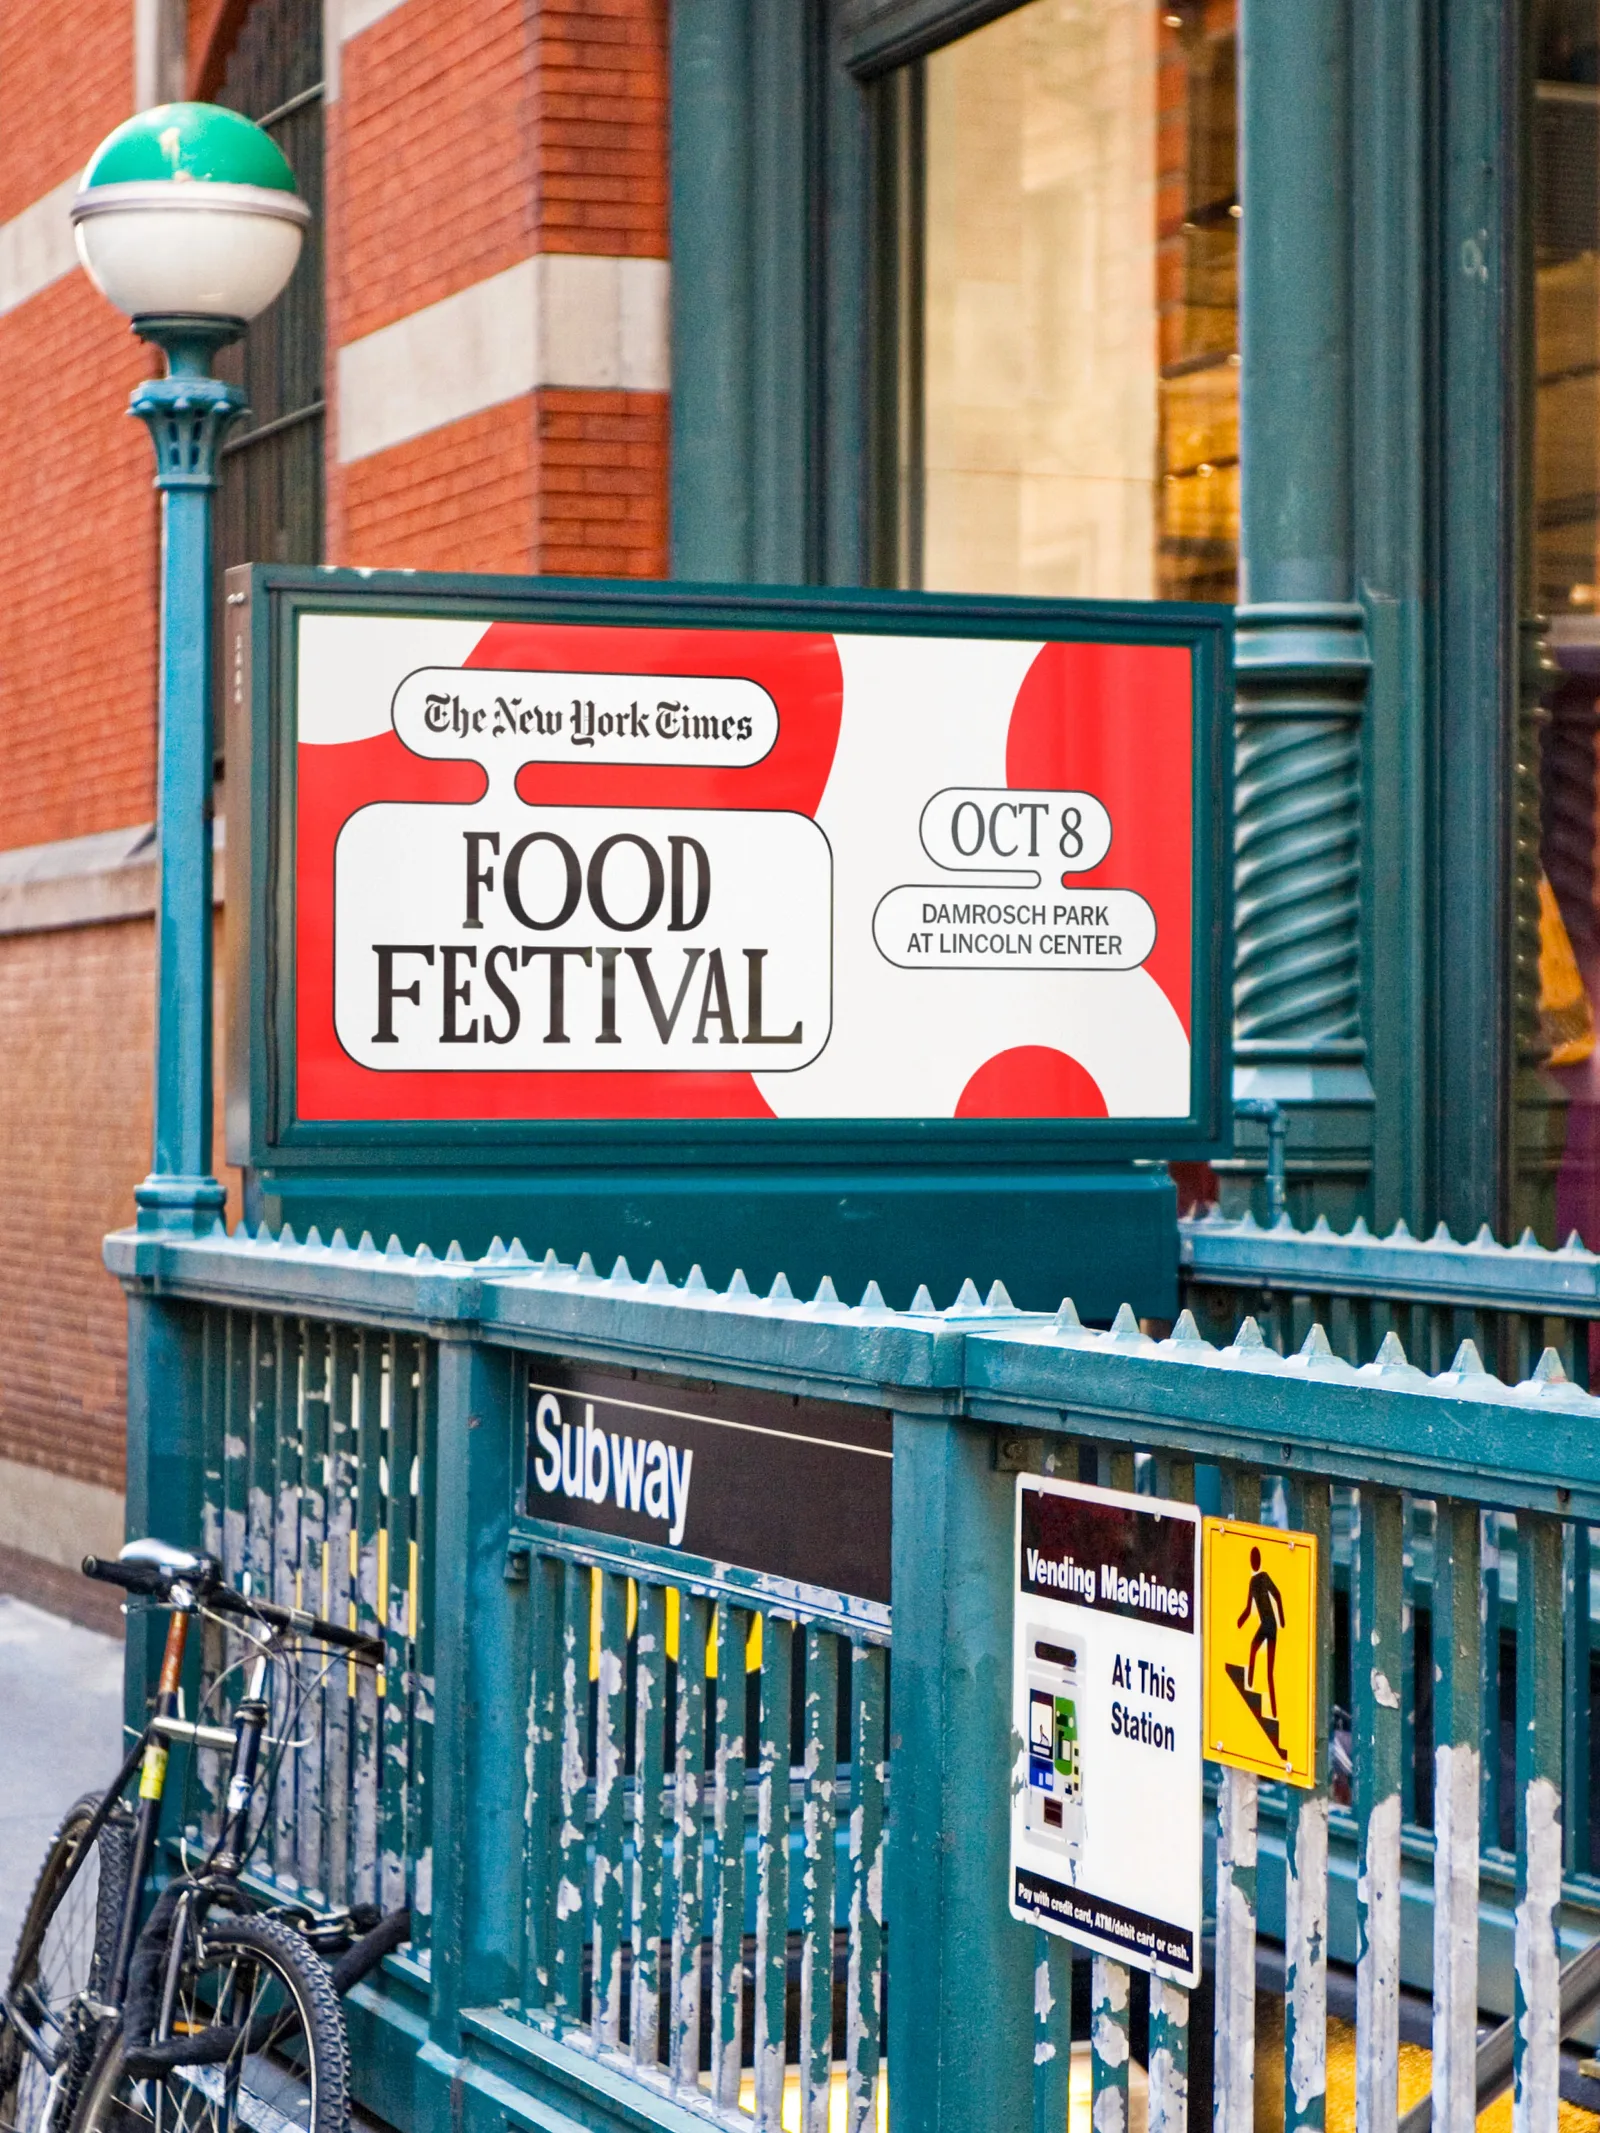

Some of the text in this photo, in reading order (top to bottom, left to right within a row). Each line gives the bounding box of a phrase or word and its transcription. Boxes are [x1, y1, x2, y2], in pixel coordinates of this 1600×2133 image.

[424, 693, 753, 748] The New York Times
[951, 801, 1083, 858] OCT 8
[462, 831, 711, 932] FOOD
[922, 903, 1109, 926] DAMROSCH PARK
[907, 933, 1122, 955] AT LINCOLN CENTER
[371, 944, 803, 1045] FESTIVAL
[535, 1393, 693, 1546] Subway
[1026, 1547, 1189, 1619] Vending Machines
[1112, 1653, 1175, 1702] At This
[1111, 1701, 1175, 1752] Station
[1018, 1882, 1190, 1962] Pay with credit card, ATM/debit card or cash.
